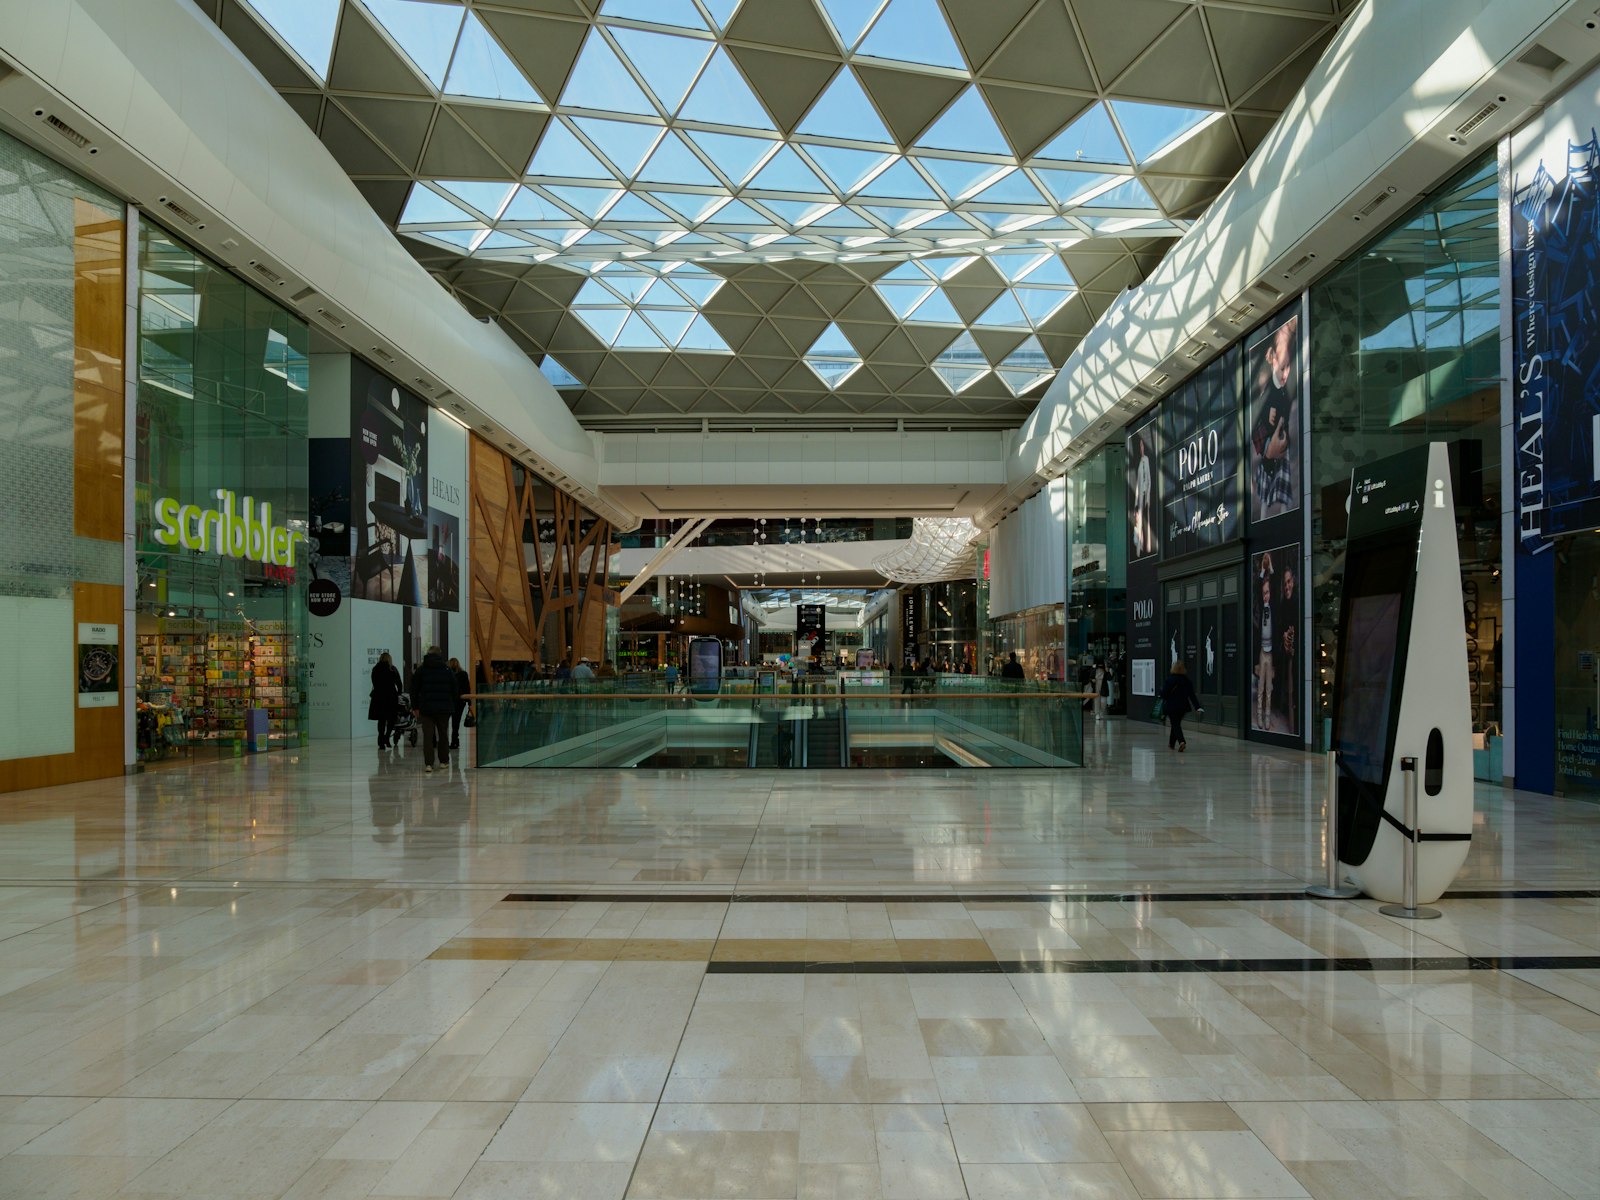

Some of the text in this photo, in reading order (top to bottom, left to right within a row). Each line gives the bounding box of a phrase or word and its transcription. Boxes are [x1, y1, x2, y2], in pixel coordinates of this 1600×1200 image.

[1519, 219, 1545, 543] HEAL'S Where design lives
[1178, 429, 1218, 481] POLO
[432, 476, 460, 506] HEAL'S
[154, 488, 304, 567] scribbler
[1133, 598, 1154, 620] POLO
[1557, 729, 1572, 739] Find
[1573, 729, 1592, 740] Heal's
[1558, 741, 1577, 751] Home
[1558, 752, 1574, 763] Level
[1582, 758, 1597, 766] near
[1558, 764, 1592, 777] John Lewis
